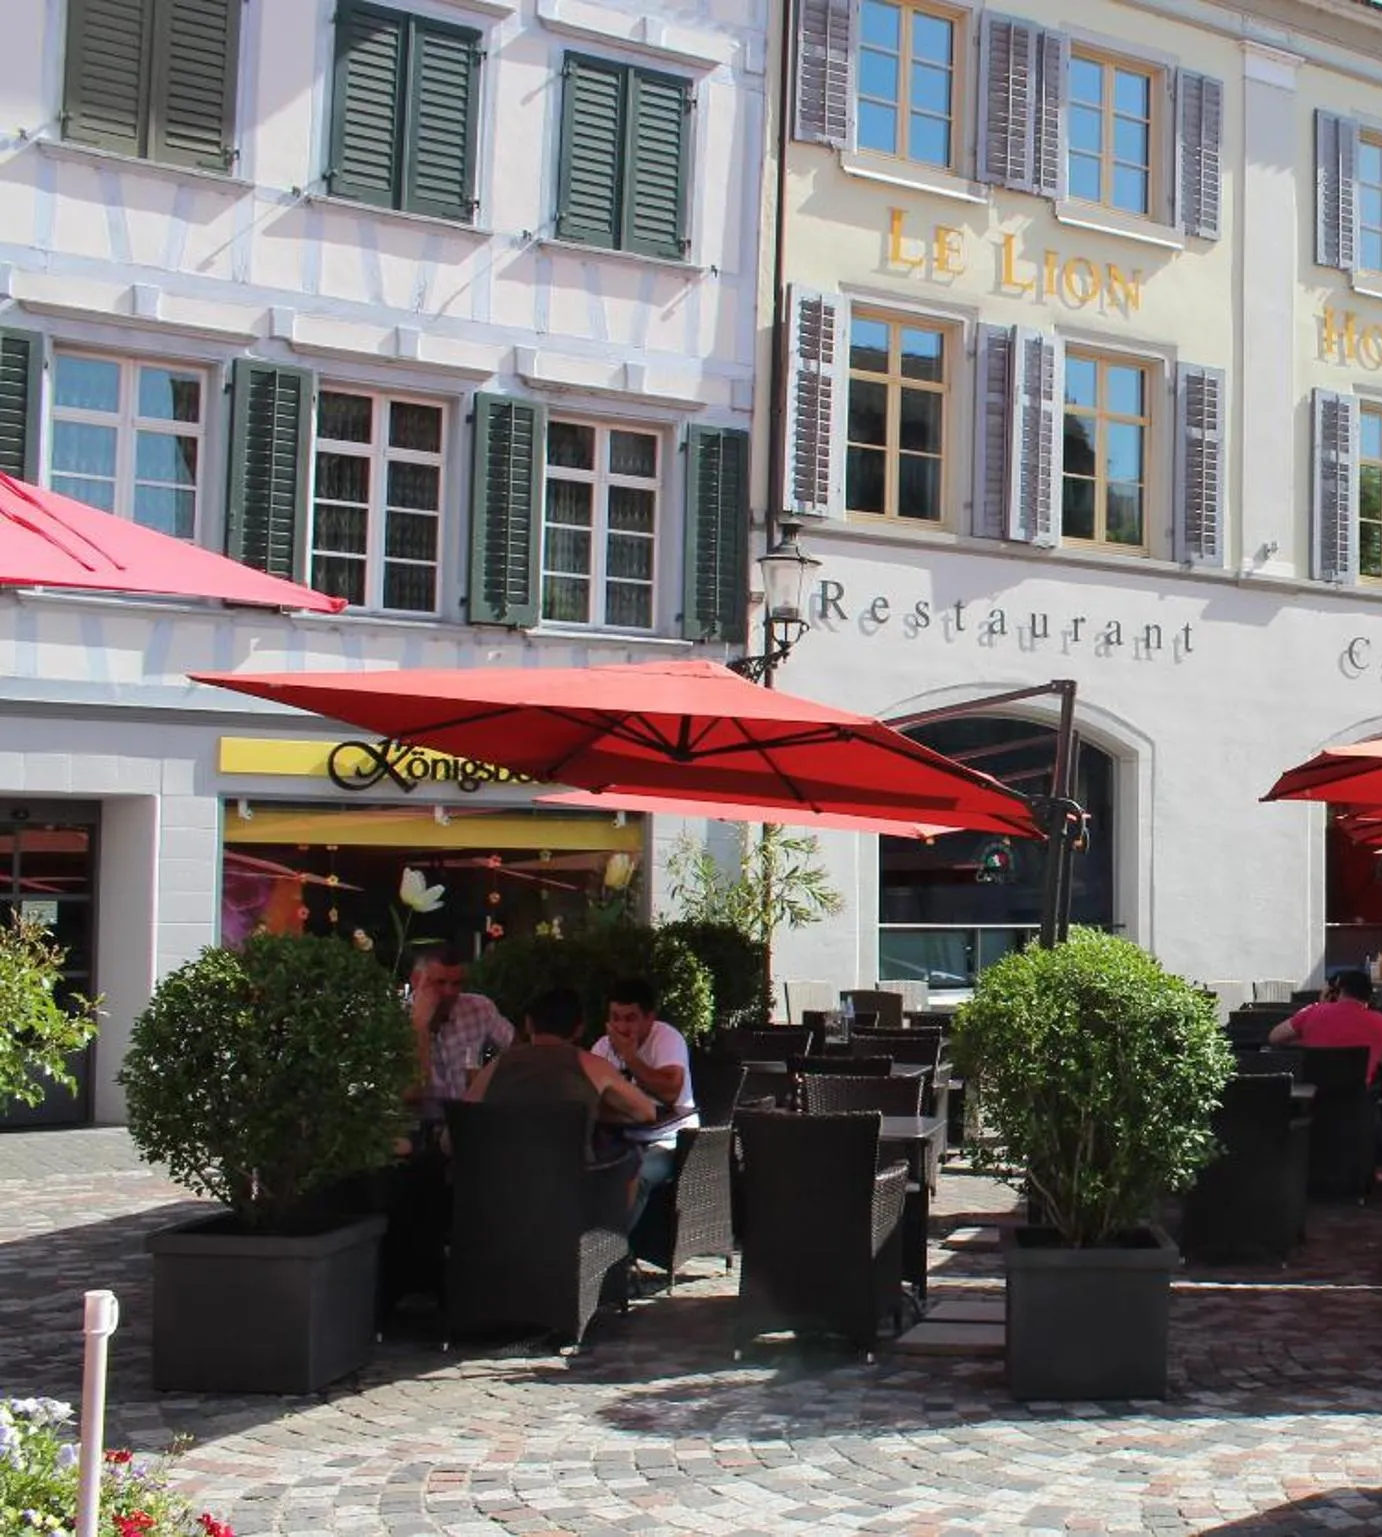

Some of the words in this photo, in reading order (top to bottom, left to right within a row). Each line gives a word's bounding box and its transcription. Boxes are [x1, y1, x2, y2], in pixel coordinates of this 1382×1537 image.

[886, 205, 965, 276] LE
[1000, 232, 1146, 312] LION
[818, 578, 1195, 654] Restaurant
